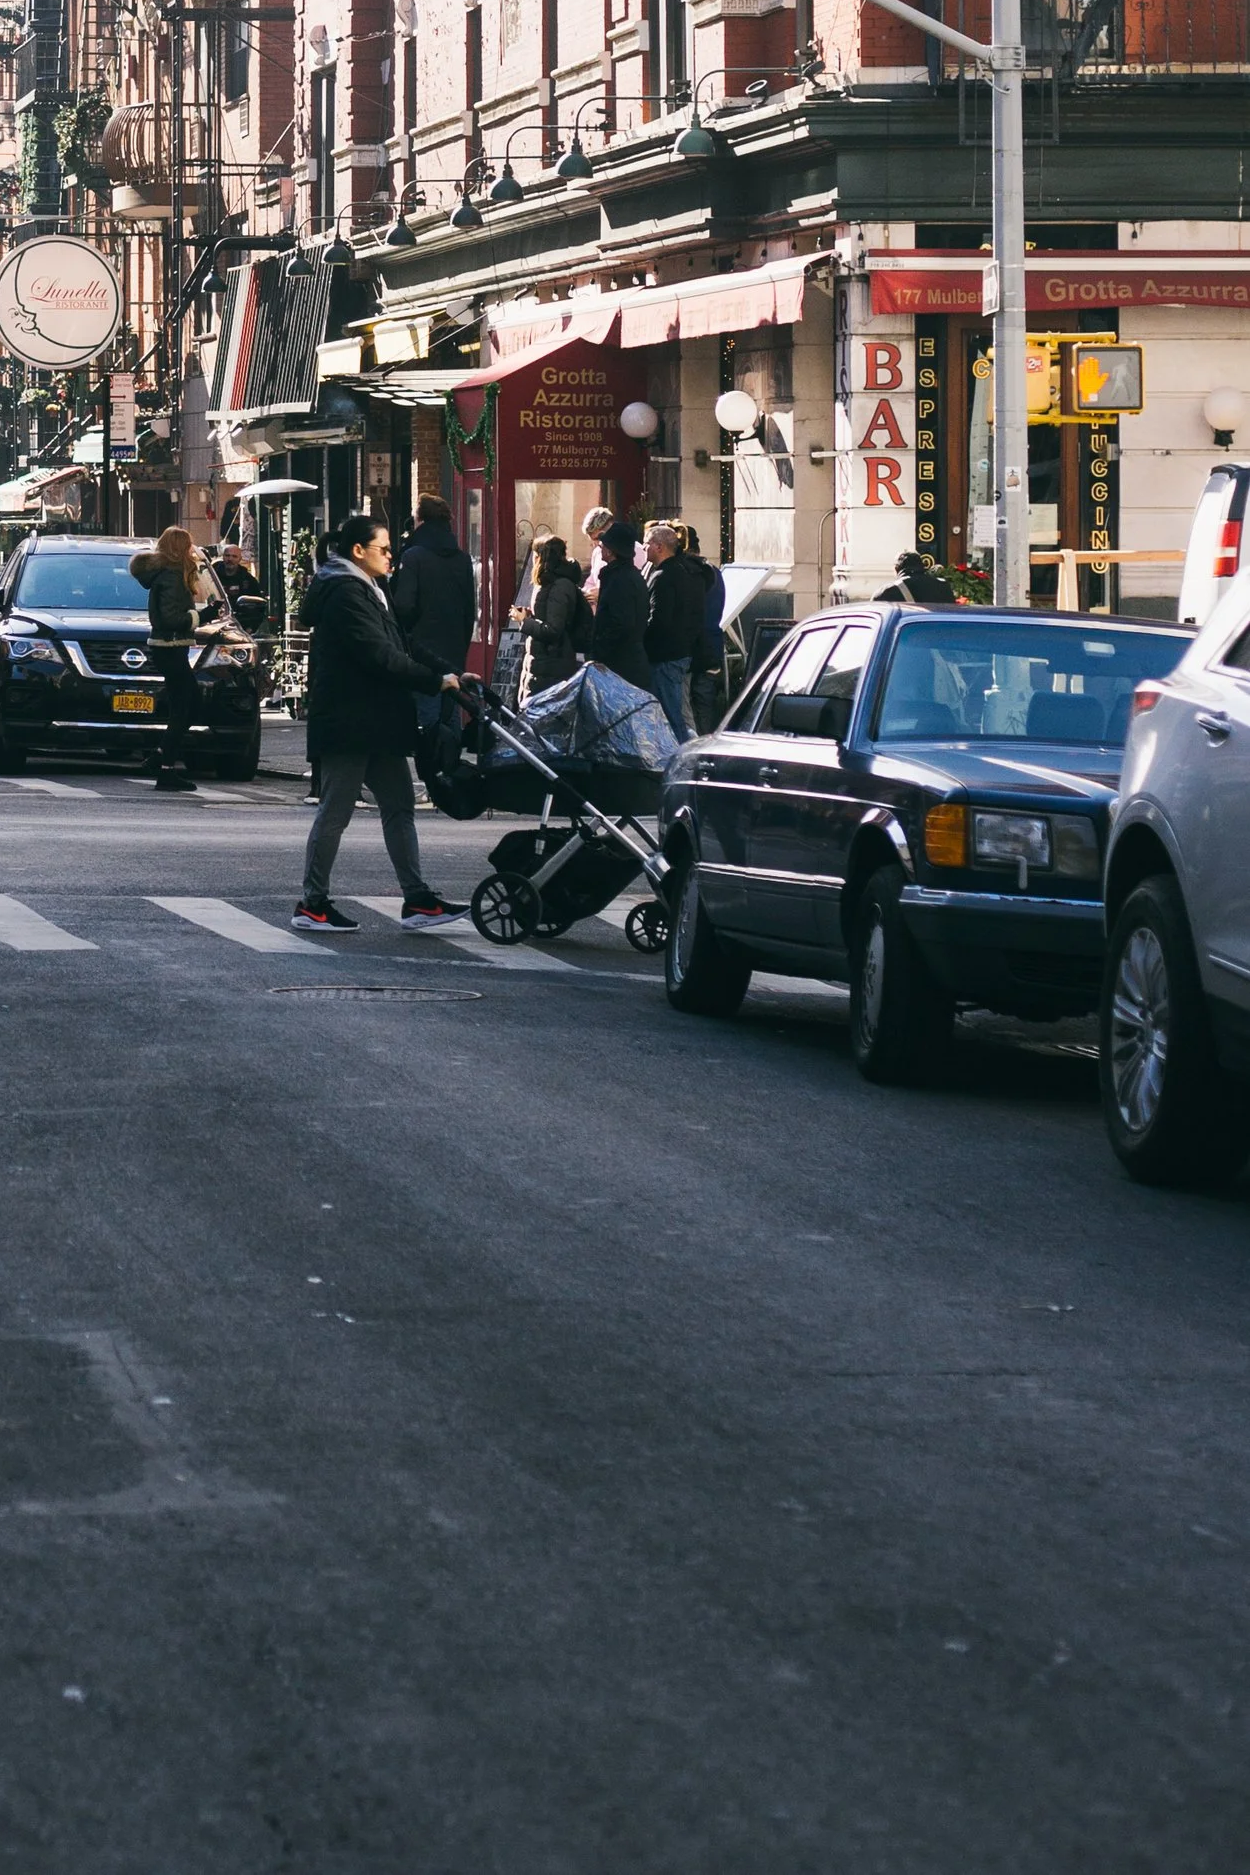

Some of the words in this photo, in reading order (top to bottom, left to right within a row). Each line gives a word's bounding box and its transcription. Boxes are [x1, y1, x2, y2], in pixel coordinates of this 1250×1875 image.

[28, 276, 108, 302] Lunella
[894, 289, 923, 305] 177
[927, 288, 984, 305] Mulber
[1045, 278, 1133, 302] Grotta
[1141, 279, 1249, 301] Azzurra
[55, 301, 108, 309] RISTORANTE
[541, 366, 607, 385] Grotta
[533, 389, 615, 406] Azzurra
[858, 342, 909, 506] BAR
[545, 431, 574, 441] Since
[578, 432, 602, 442] 1908
[531, 445, 549, 454] 177
[552, 445, 599, 456] Mulberry
[602, 445, 617, 455] St.
[918, 337, 936, 570] ESPRESSO
[540, 458, 608, 468] 212.925.8775
